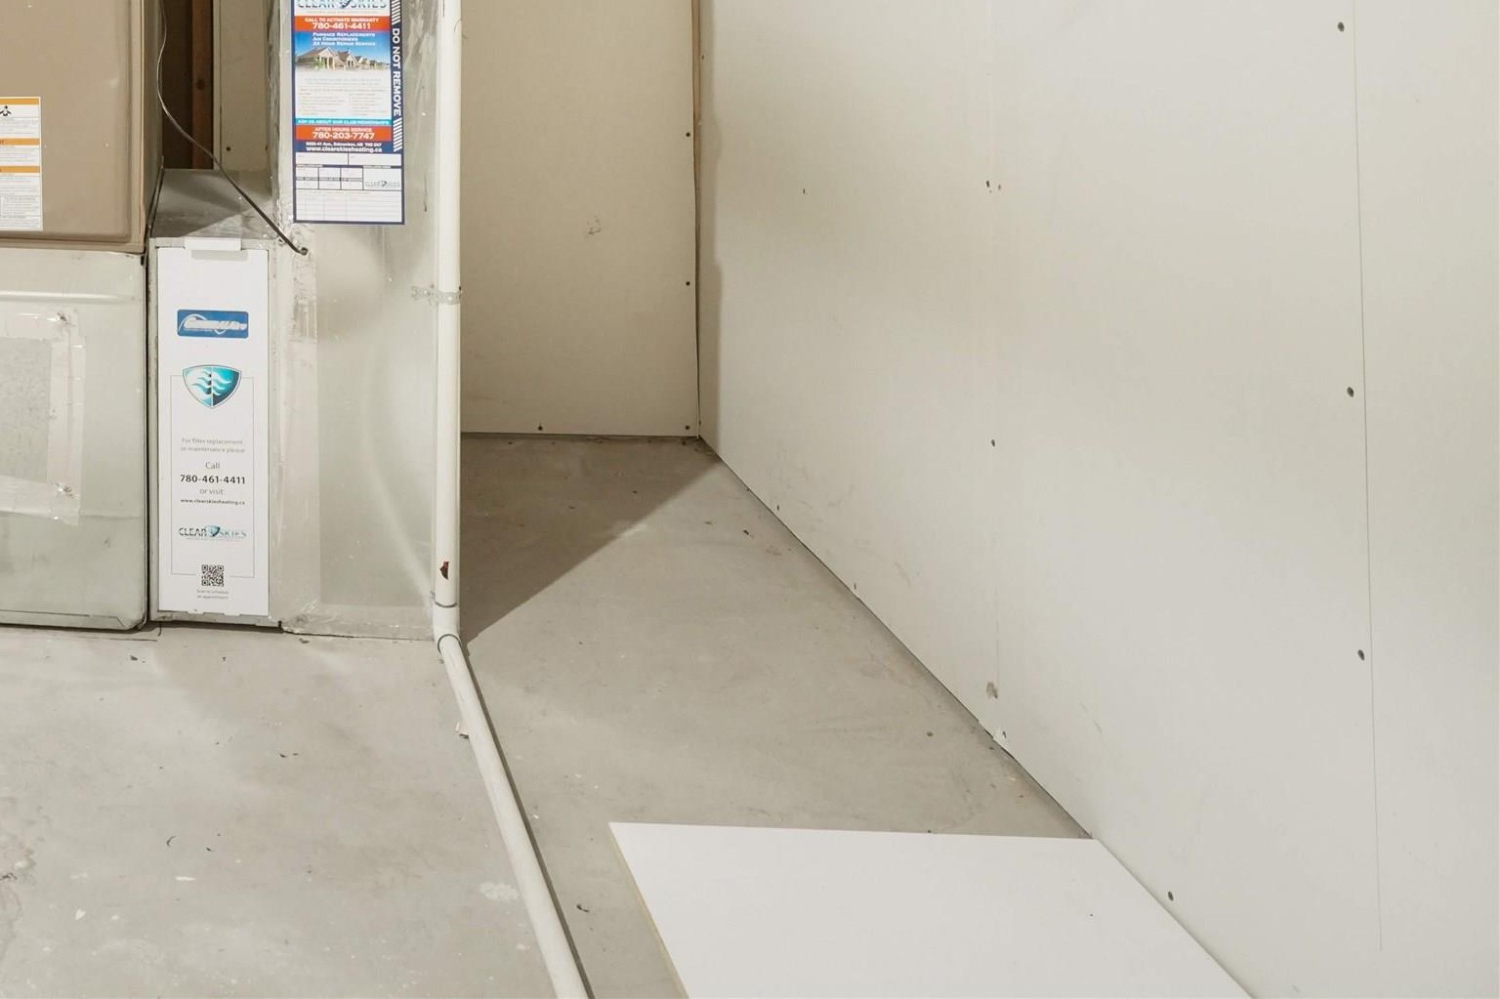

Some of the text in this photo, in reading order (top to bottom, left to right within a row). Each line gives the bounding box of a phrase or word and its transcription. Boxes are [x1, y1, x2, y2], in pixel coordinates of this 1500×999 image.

[392, 28, 402, 116] DO NOT REMOVE
[180, 474, 245, 485] 780-461-4411
[179, 528, 207, 536] CLEAR
